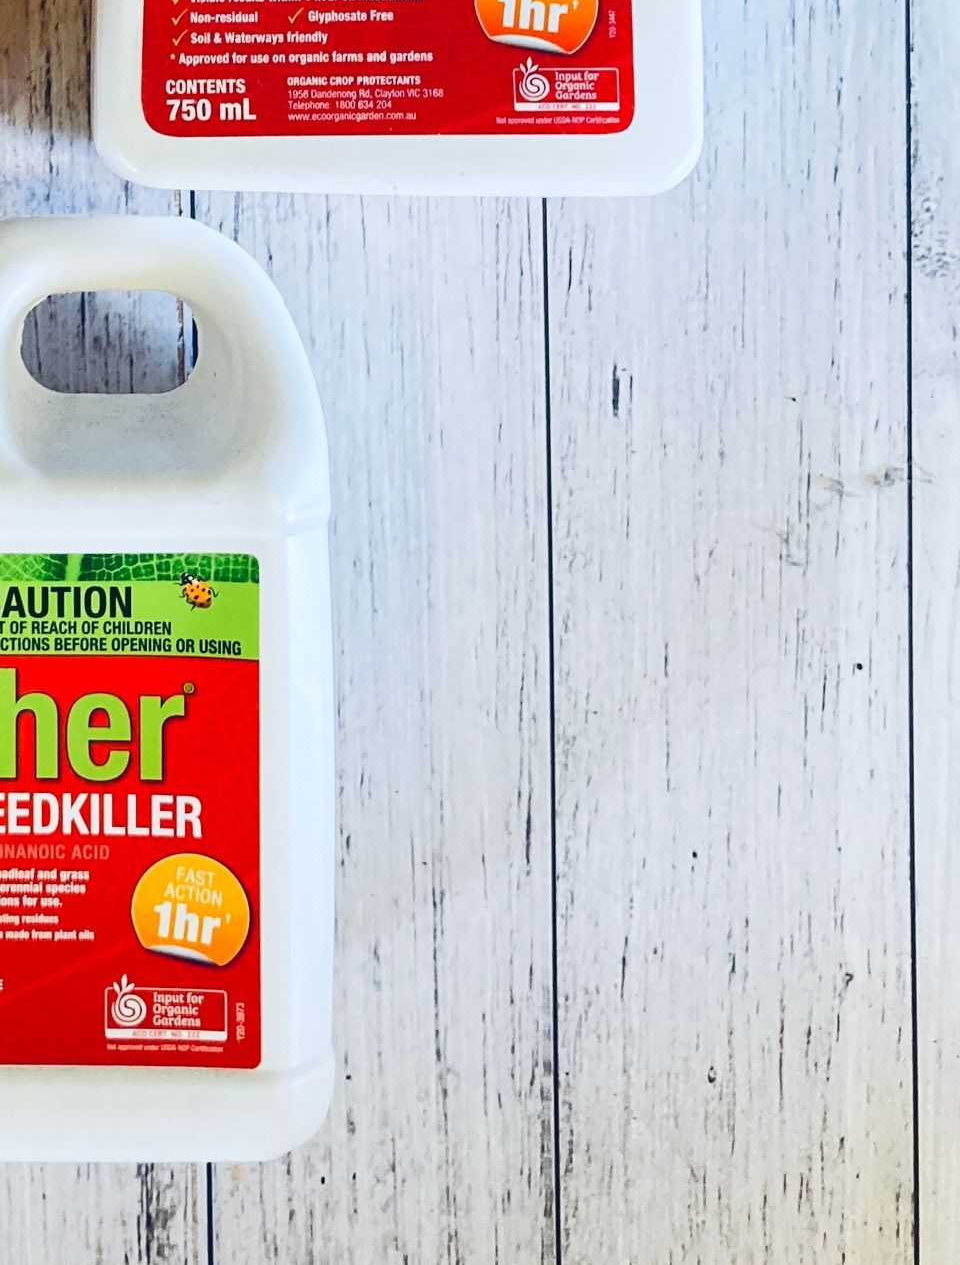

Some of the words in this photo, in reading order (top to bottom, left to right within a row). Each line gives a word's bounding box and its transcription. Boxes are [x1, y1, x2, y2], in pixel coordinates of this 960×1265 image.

[190, 11, 258, 23] Non-residual
[307, 9, 367, 24] Glyphosate
[370, 9, 393, 21] Free
[190, 31, 211, 44] Soil
[224, 31, 284, 45] Waterways
[286, 30, 328, 44] friendly
[178, 52, 229, 66] Approved
[231, 51, 247, 63] for
[250, 53, 269, 63] use
[271, 53, 285, 63] on
[288, 51, 329, 65] organic
[331, 50, 363, 62] farms
[366, 50, 386, 62] and
[389, 50, 433, 64] gardens
[287, 75, 327, 86] ORGANIC
[329, 75, 354, 85] CROP
[356, 75, 421, 85] PROTECTANTS
[555, 71, 582, 83] Input
[583, 70, 599, 83] for
[165, 78, 245, 94] CONTENTS
[554, 80, 595, 94] Organic
[555, 90, 597, 99] Gardens
[166, 98, 211, 121] 750
[219, 98, 256, 120] mL
[9, 620, 27, 634] OF
[31, 620, 77, 634] REACH
[81, 620, 99, 634] OF
[102, 620, 171, 635] CHILDREN
[54, 637, 107, 652] BEFORE
[111, 637, 172, 653] OPENING
[176, 638, 195, 654] OR
[199, 639, 241, 656] USING
[71, 844, 109, 860] ACID
[176, 865, 214, 888] FAST
[164, 883, 222, 906] ACTION
[152, 991, 184, 1007] Input
[186, 991, 204, 1007] for
[152, 1003, 198, 1019] Organic
[152, 1014, 201, 1027] Gardens
